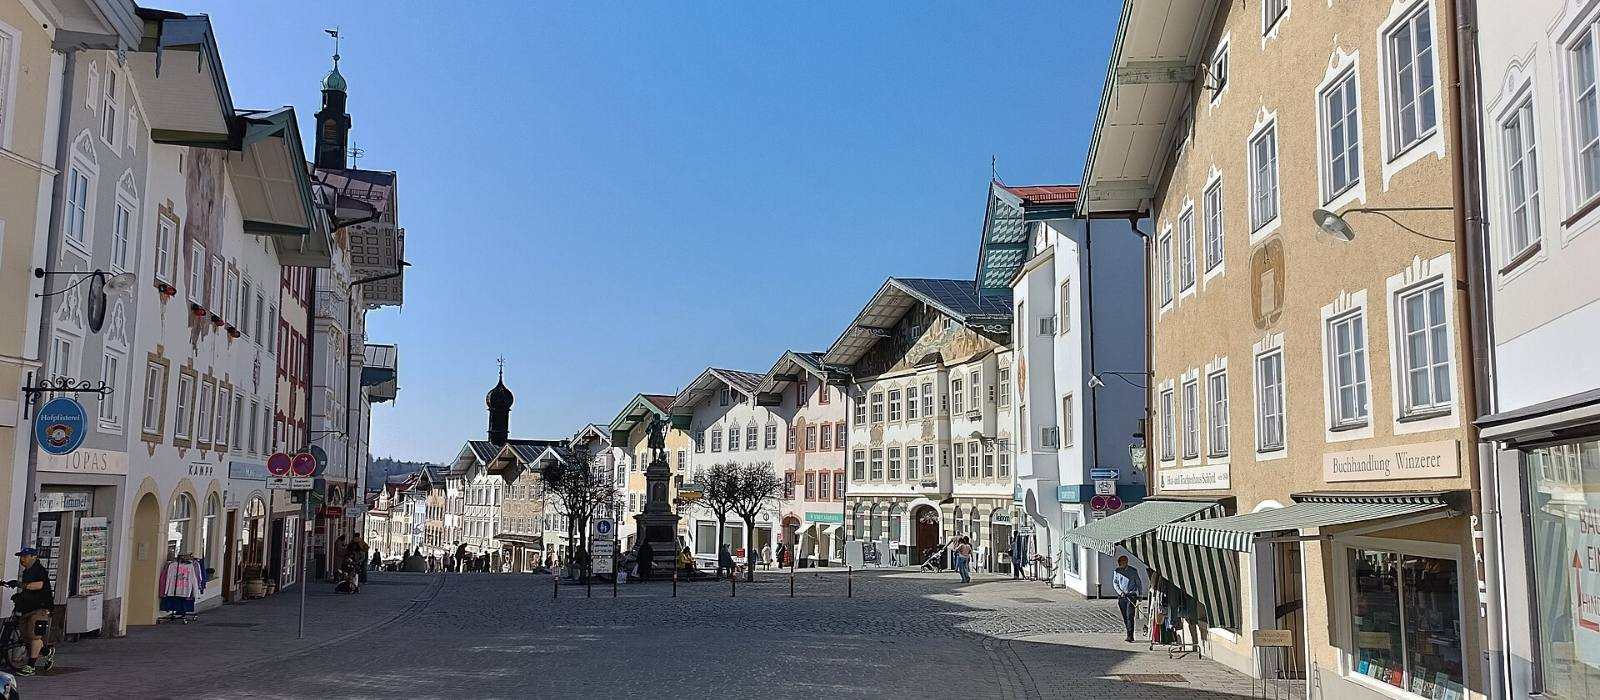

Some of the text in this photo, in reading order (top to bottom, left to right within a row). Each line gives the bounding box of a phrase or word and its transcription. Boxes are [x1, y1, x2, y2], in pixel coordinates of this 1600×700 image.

[64, 450, 108, 471] TOPAS
[1333, 452, 1441, 476] Buchhandlung Winzerer
